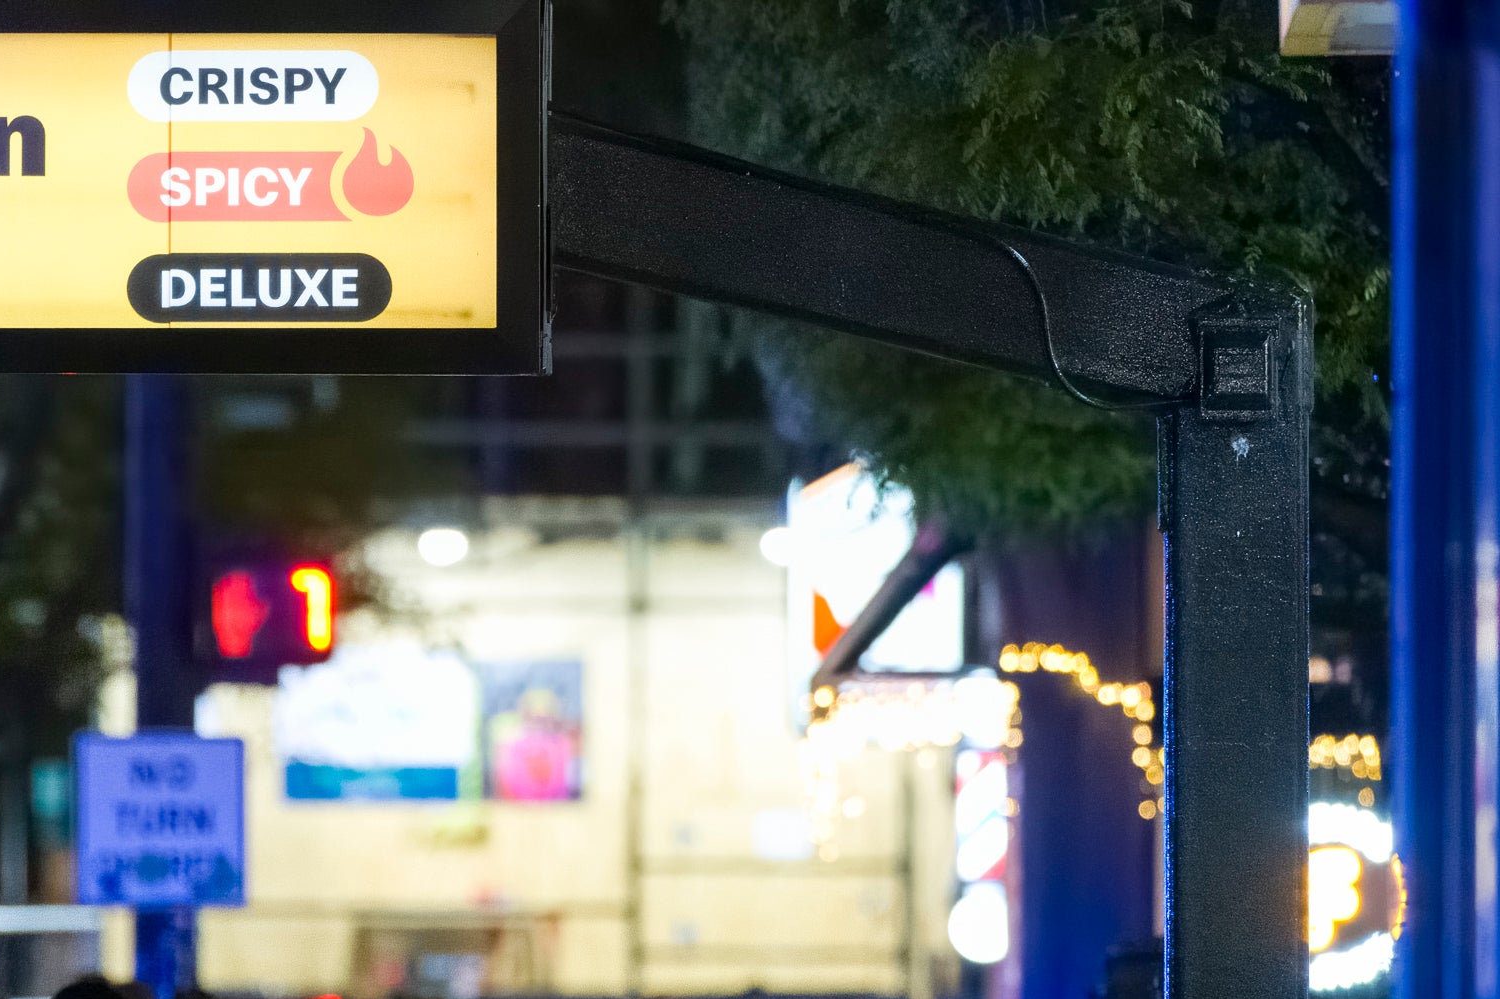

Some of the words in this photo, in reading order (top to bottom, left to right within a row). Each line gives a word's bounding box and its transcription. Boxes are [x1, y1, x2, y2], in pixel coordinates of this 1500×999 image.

[159, 66, 348, 106] CRISPY
[159, 166, 313, 207] SPICY
[160, 267, 359, 309] DELUXE
[289, 566, 333, 652] 1
[128, 755, 198, 791] NO
[114, 802, 216, 837] TURN
